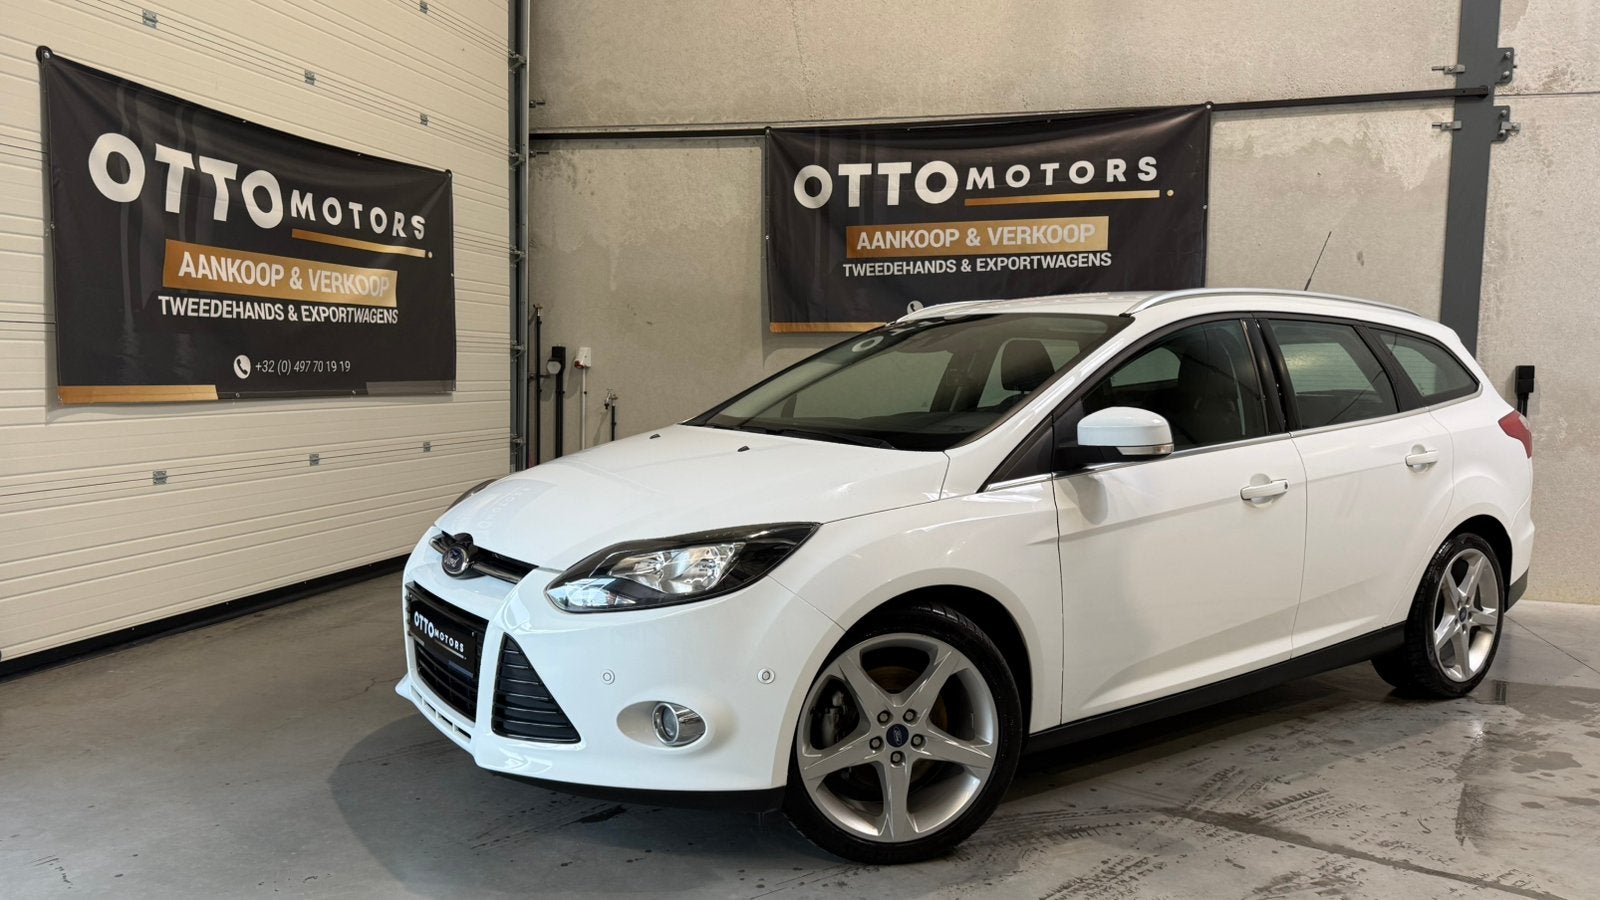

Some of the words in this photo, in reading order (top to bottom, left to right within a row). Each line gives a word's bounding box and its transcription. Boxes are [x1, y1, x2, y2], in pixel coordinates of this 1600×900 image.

[89, 132, 284, 229] OTTO
[290, 189, 426, 240] MOTORS
[793, 160, 959, 209] OTTO
[965, 156, 1158, 191] MOTORS
[856, 228, 960, 250] AANKOOP
[965, 228, 981, 247] &
[987, 223, 1096, 247] VERKOOP
[178, 251, 285, 288] AANKOOP
[289, 267, 303, 291] &
[308, 268, 391, 297] VERKOOP
[843, 259, 957, 278] TWEEDEHANDS
[960, 258, 972, 273] &
[975, 252, 1112, 273] EXPORTWAGENS
[158, 295, 285, 321] TWEEDEHANDS
[288, 305, 298, 322] &
[301, 305, 399, 325] EXPORTWAGENS
[255, 360, 275, 373] +32
[277, 359, 292, 375] (0)
[293, 360, 311, 373] 497
[312, 360, 324, 373] 70
[326, 360, 338, 373] 19
[339, 360, 351, 373] 19
[414, 611, 434, 638] OTTO
[434, 630, 464, 652] MOTORS
